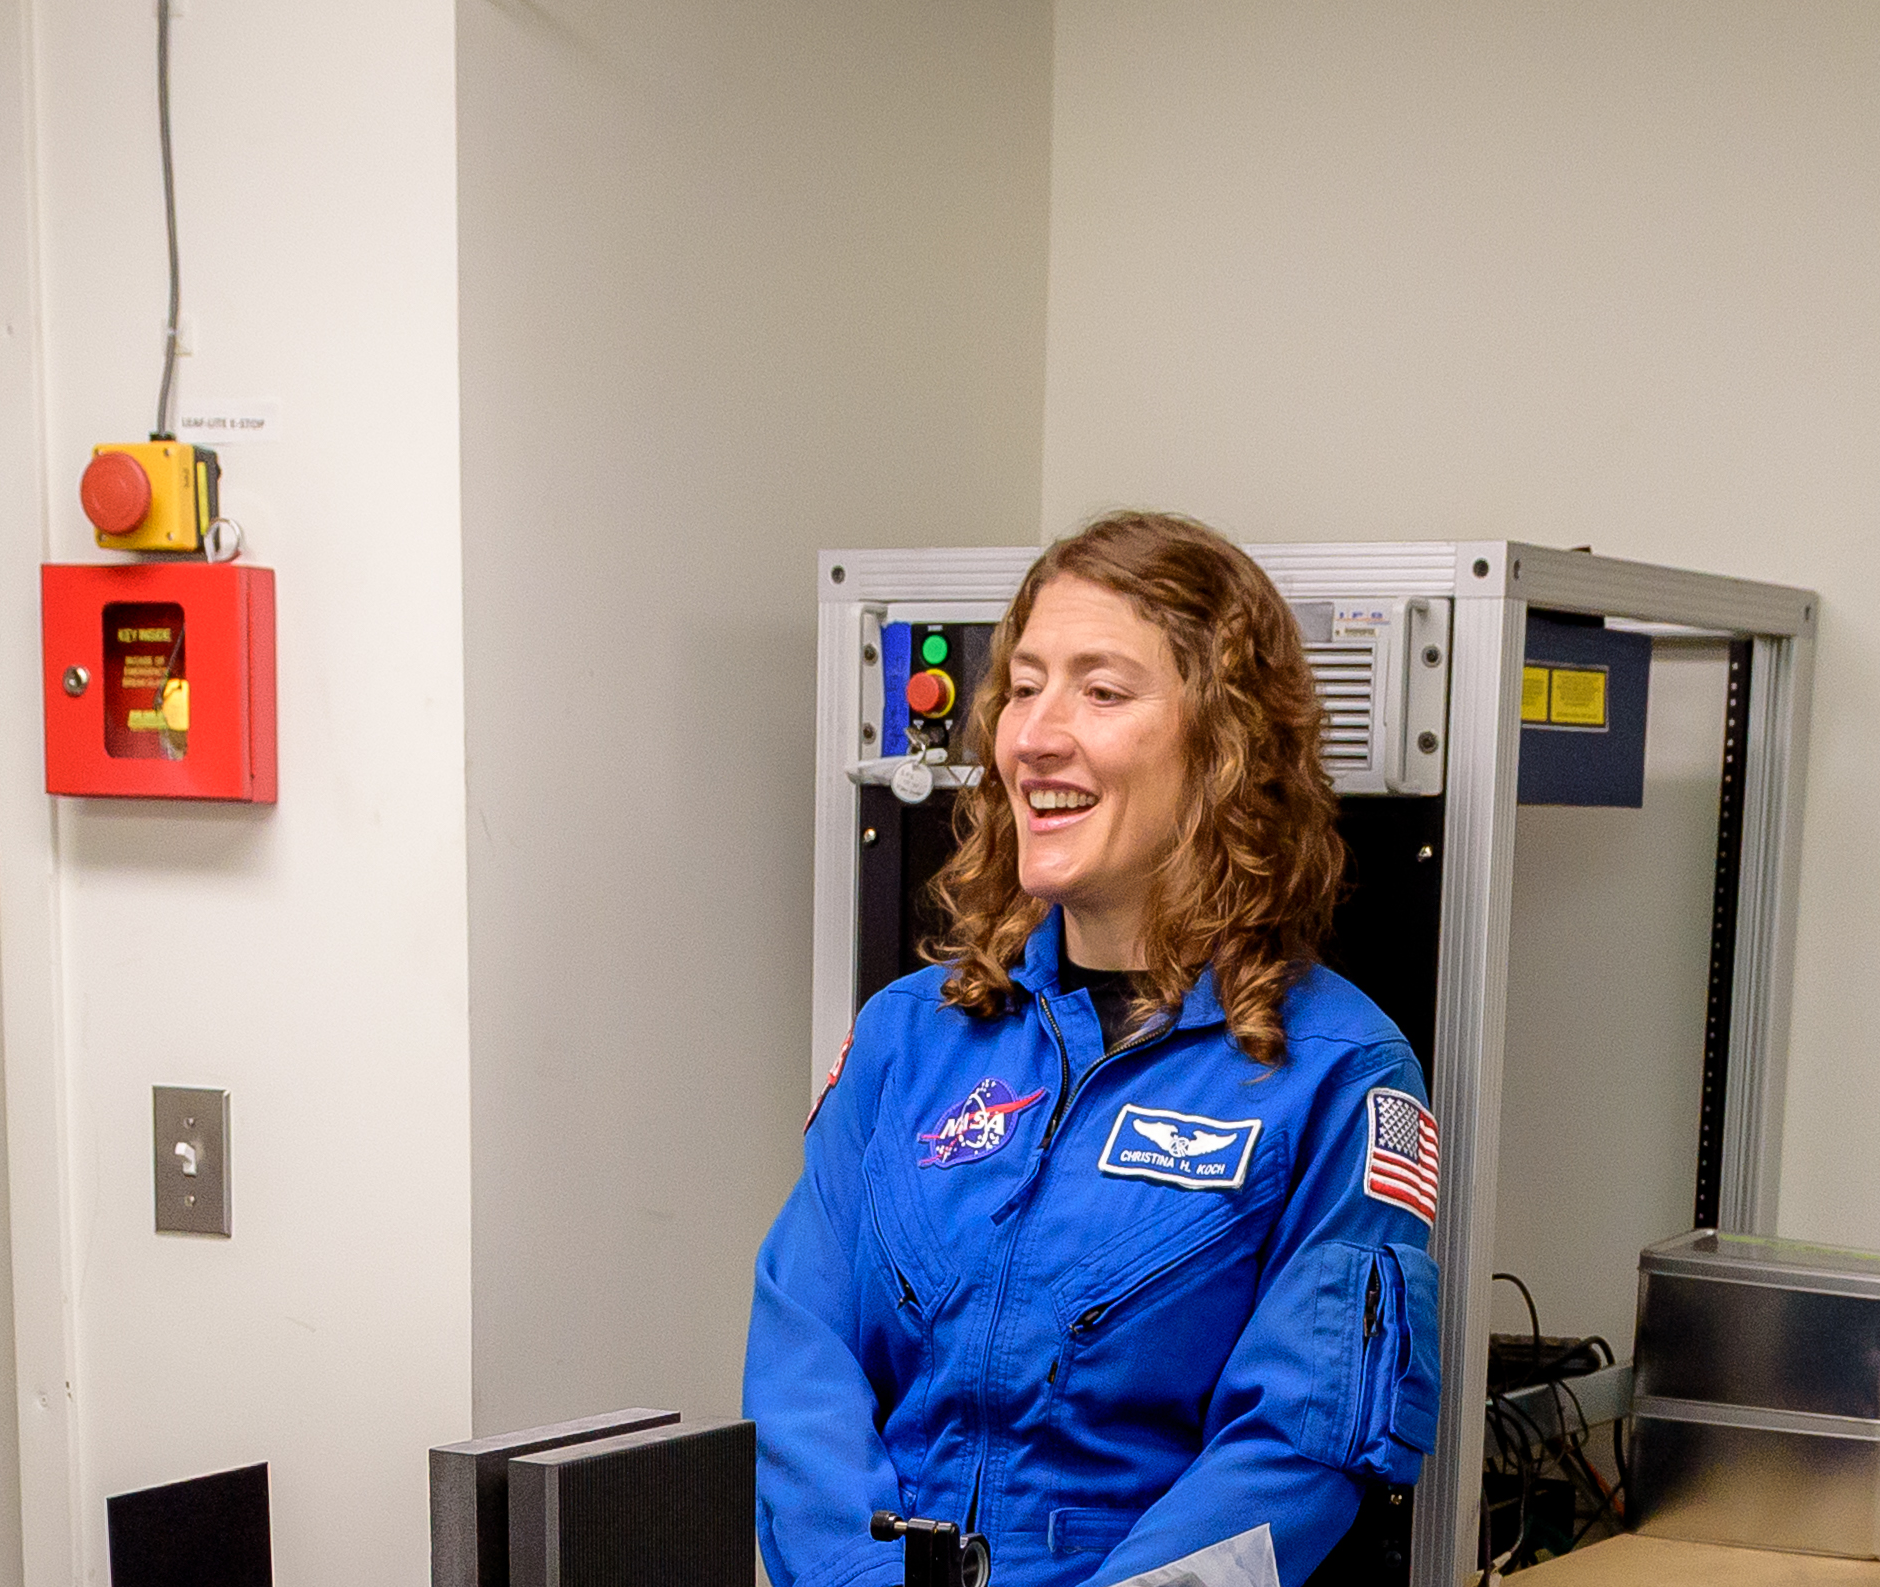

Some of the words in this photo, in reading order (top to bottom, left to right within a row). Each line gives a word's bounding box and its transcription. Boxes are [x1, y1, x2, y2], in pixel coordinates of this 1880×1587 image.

[938, 1110, 1005, 1140] NASA
[1120, 1149, 1175, 1169] CHRISTINA
[1179, 1161, 1192, 1173] H.
[1195, 1163, 1226, 1176] KOCH
